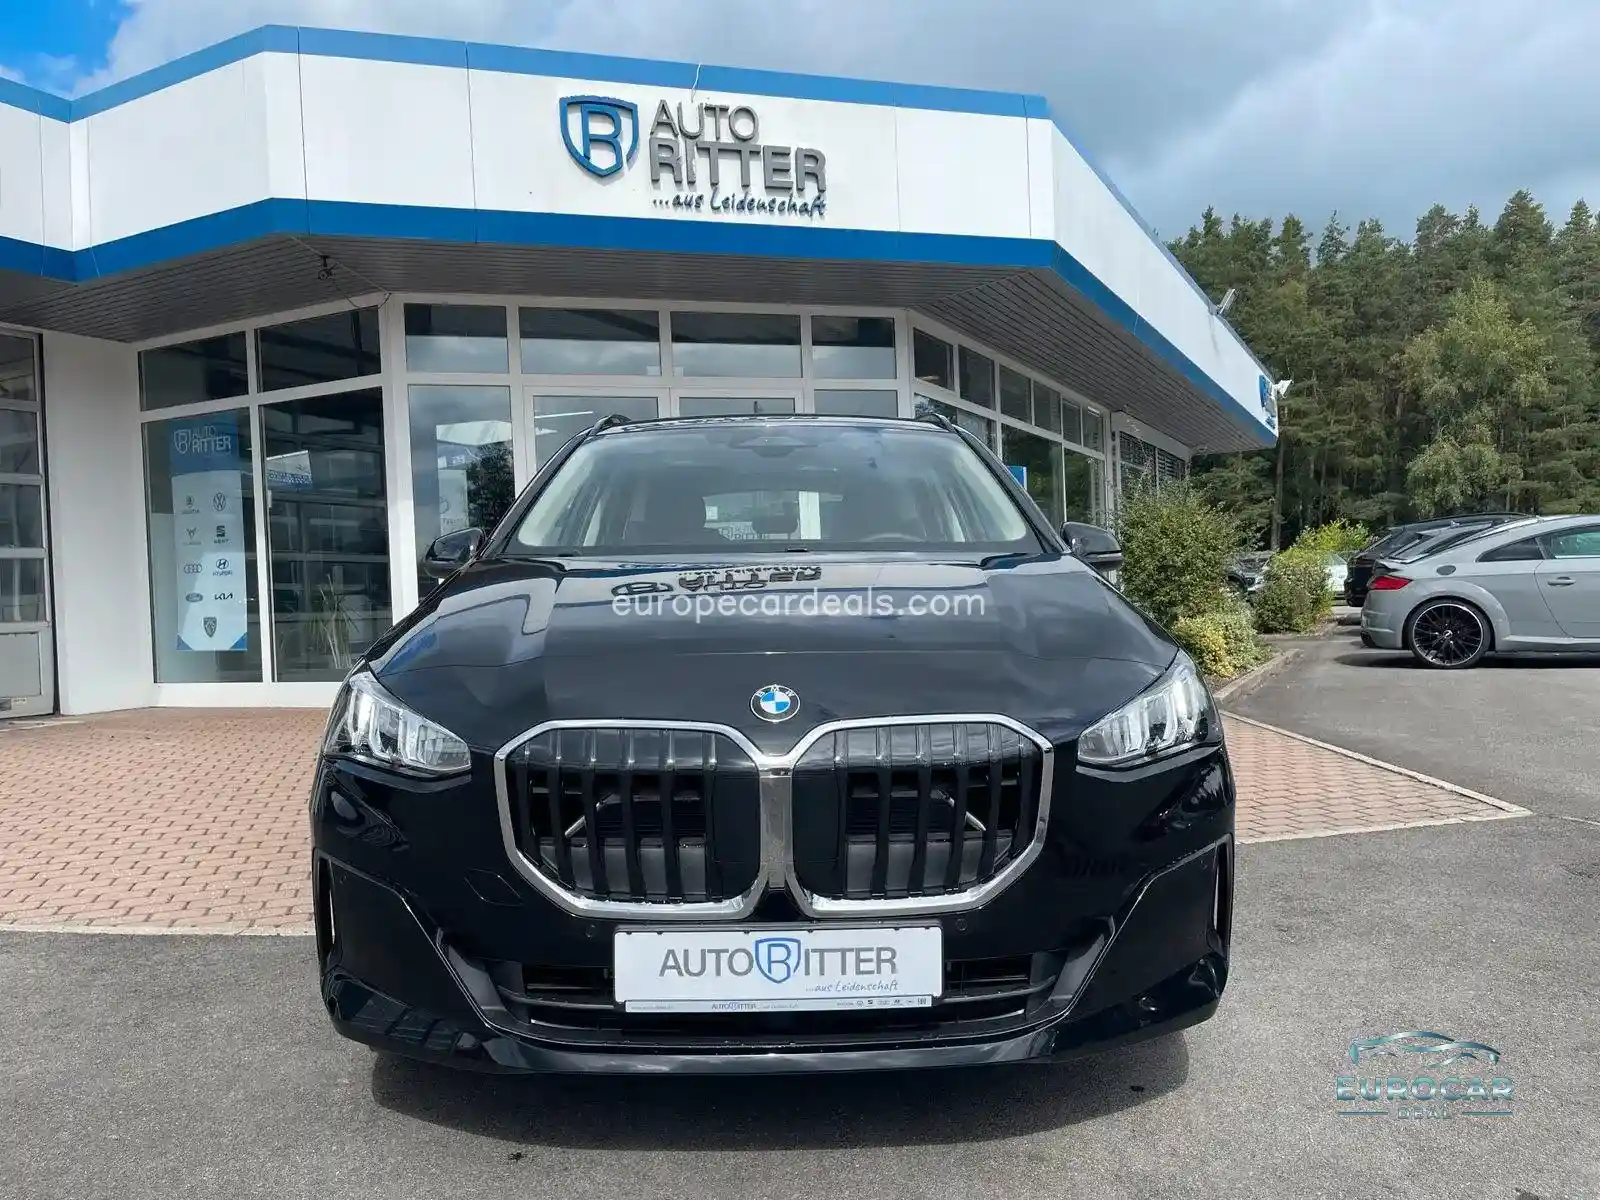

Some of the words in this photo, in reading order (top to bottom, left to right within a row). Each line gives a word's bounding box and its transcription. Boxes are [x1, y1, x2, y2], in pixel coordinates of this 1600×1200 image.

[650, 99, 759, 141] AUTO
[649, 137, 827, 193] RITTER
[709, 187, 827, 218] Leidenschaft
[192, 436, 231, 453] RITTER
[835, 979, 899, 993] Leidenschaft
